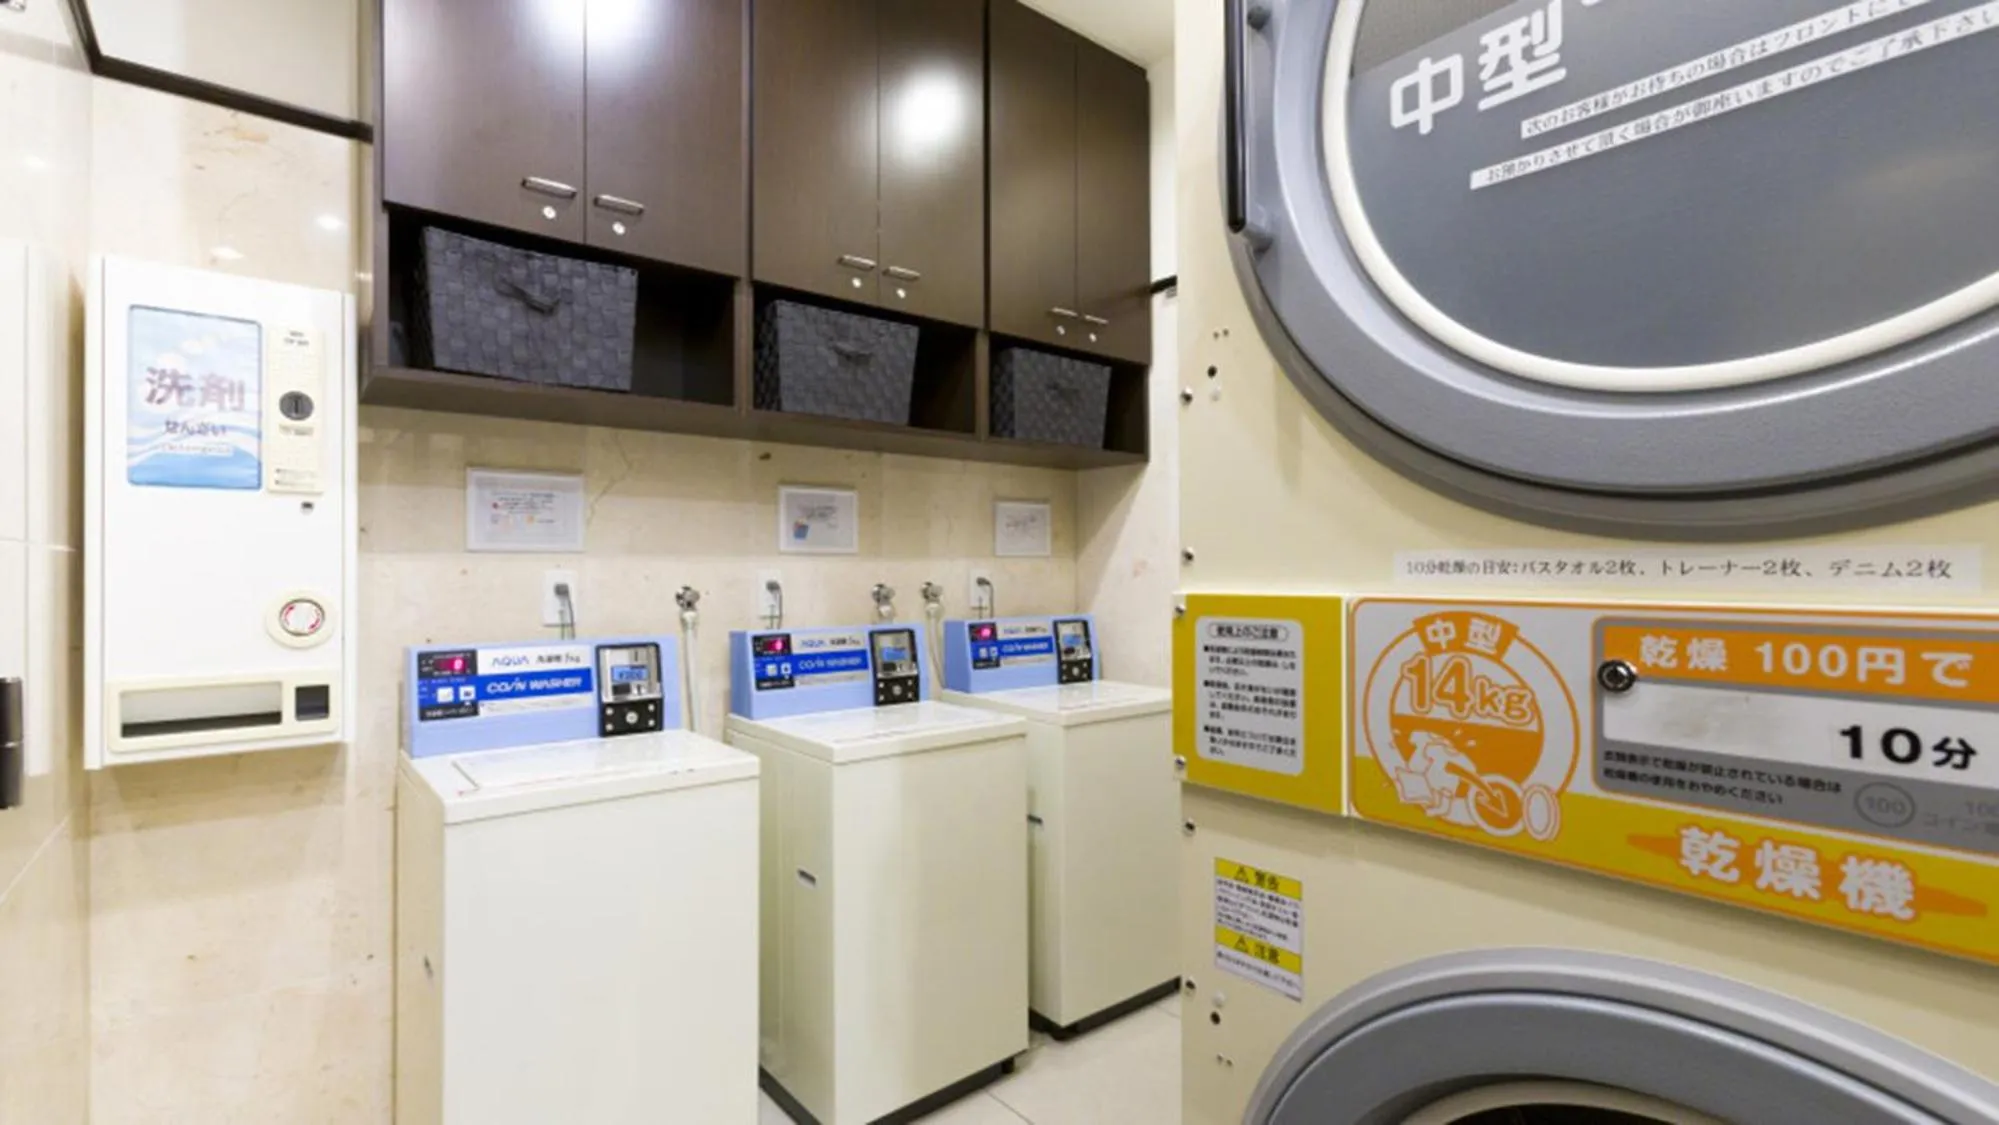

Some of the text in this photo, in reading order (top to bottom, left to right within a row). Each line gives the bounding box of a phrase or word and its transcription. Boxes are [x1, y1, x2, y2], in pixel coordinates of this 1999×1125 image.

[1390, 0, 1599, 135] 中型
[146, 366, 246, 412] 洗剤
[491, 654, 530, 667] AQUA
[1424, 616, 1501, 655] 中型
[1639, 633, 1974, 689] 乾燥 100円で
[1403, 652, 1535, 727] 14kg
[1838, 724, 1978, 771] 10分
[1677, 825, 1918, 921] 乾燥機
